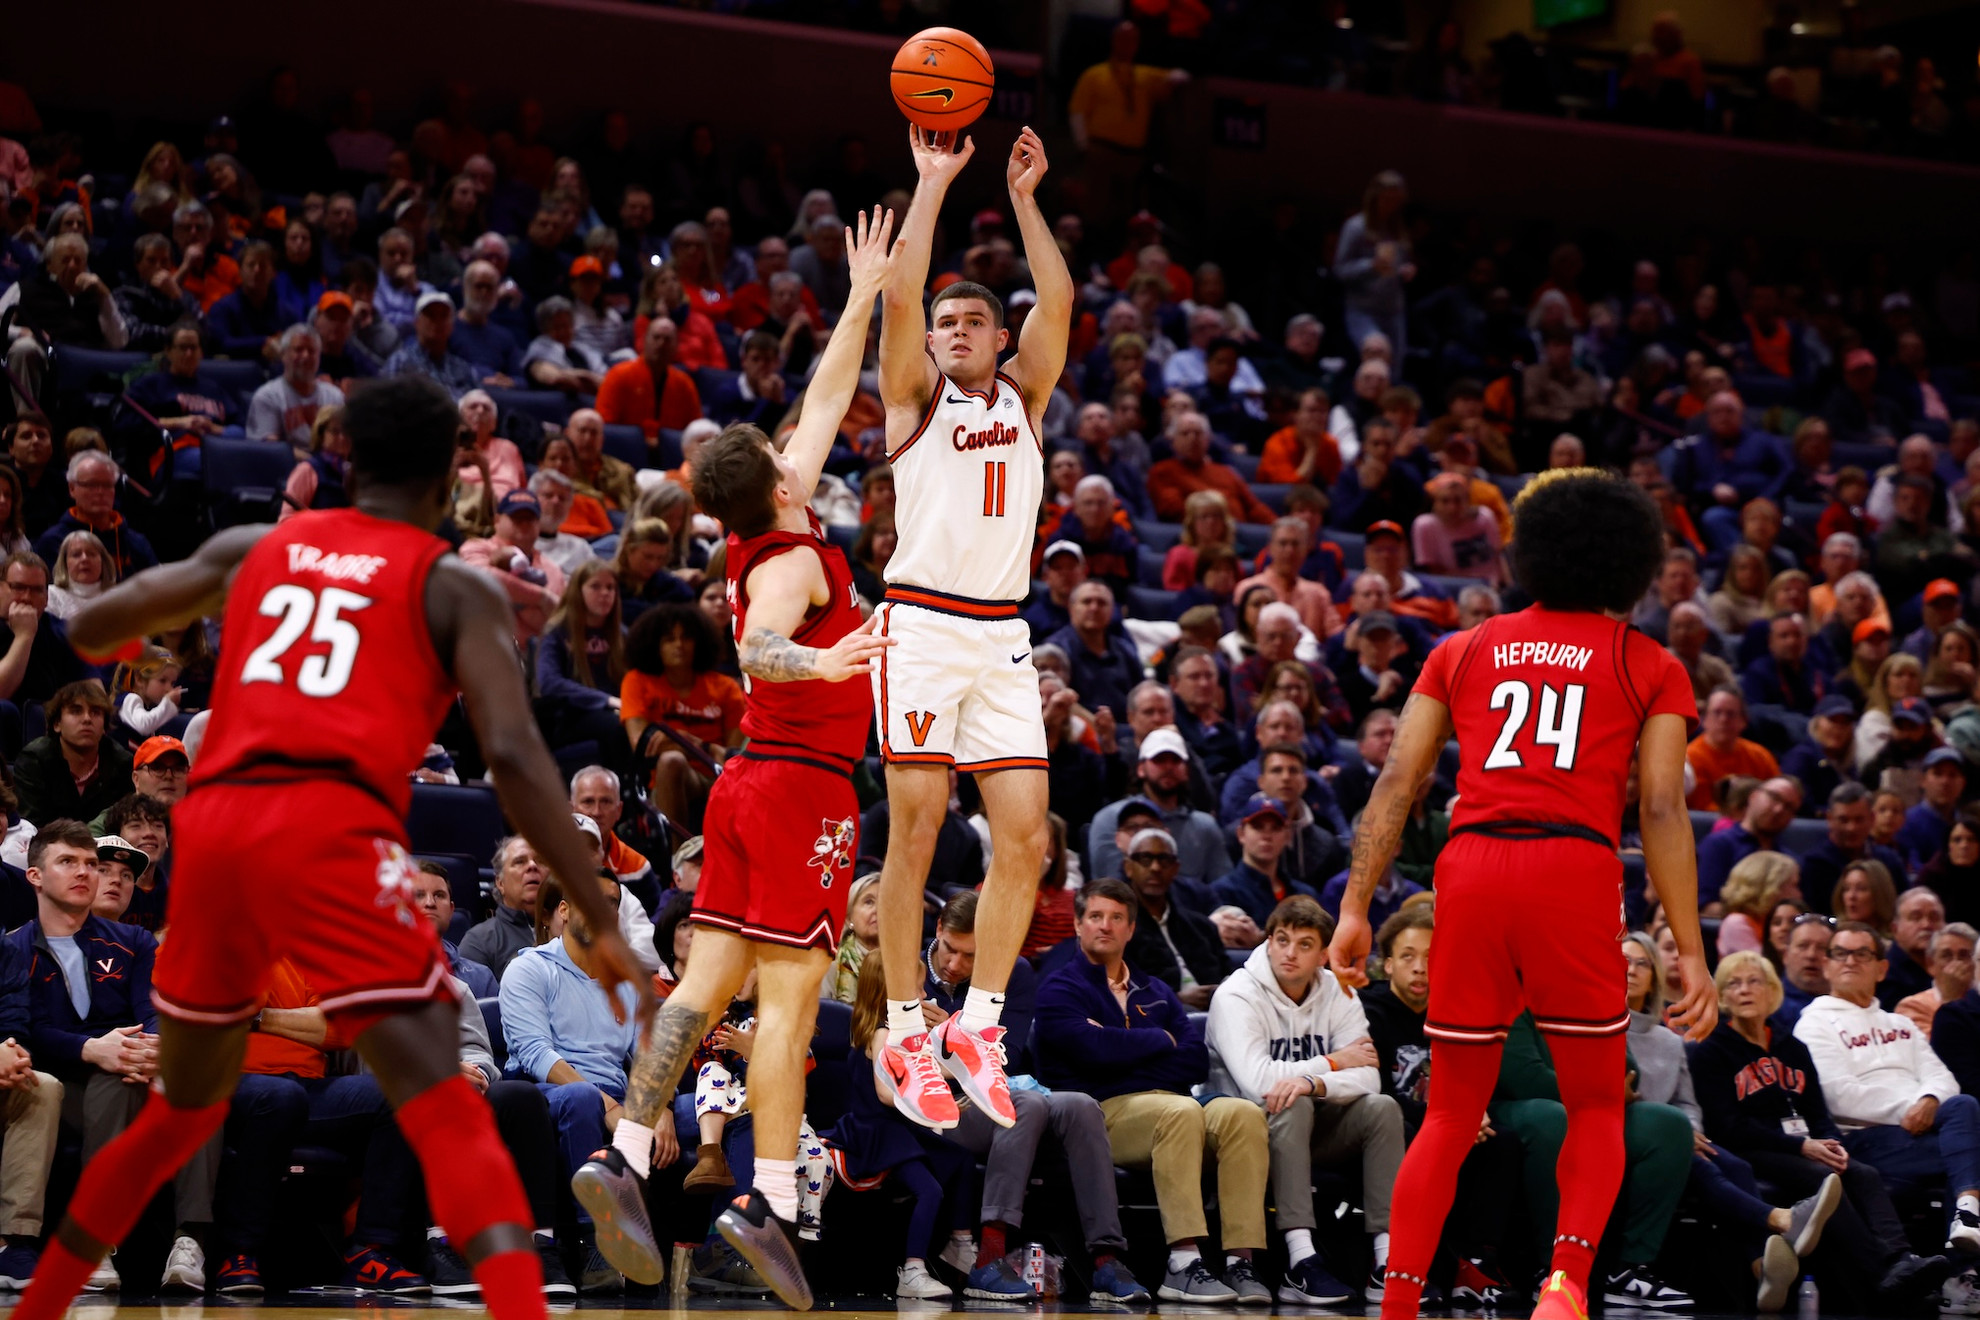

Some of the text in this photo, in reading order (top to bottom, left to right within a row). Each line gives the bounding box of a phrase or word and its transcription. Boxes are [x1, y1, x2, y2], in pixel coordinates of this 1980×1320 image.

[983, 461, 1006, 517] 11
[240, 583, 375, 698] 25
[1493, 641, 1594, 672] HEPBURN
[905, 710, 936, 747] V
[1482, 679, 1587, 773] 24
[96, 958, 114, 973] V
